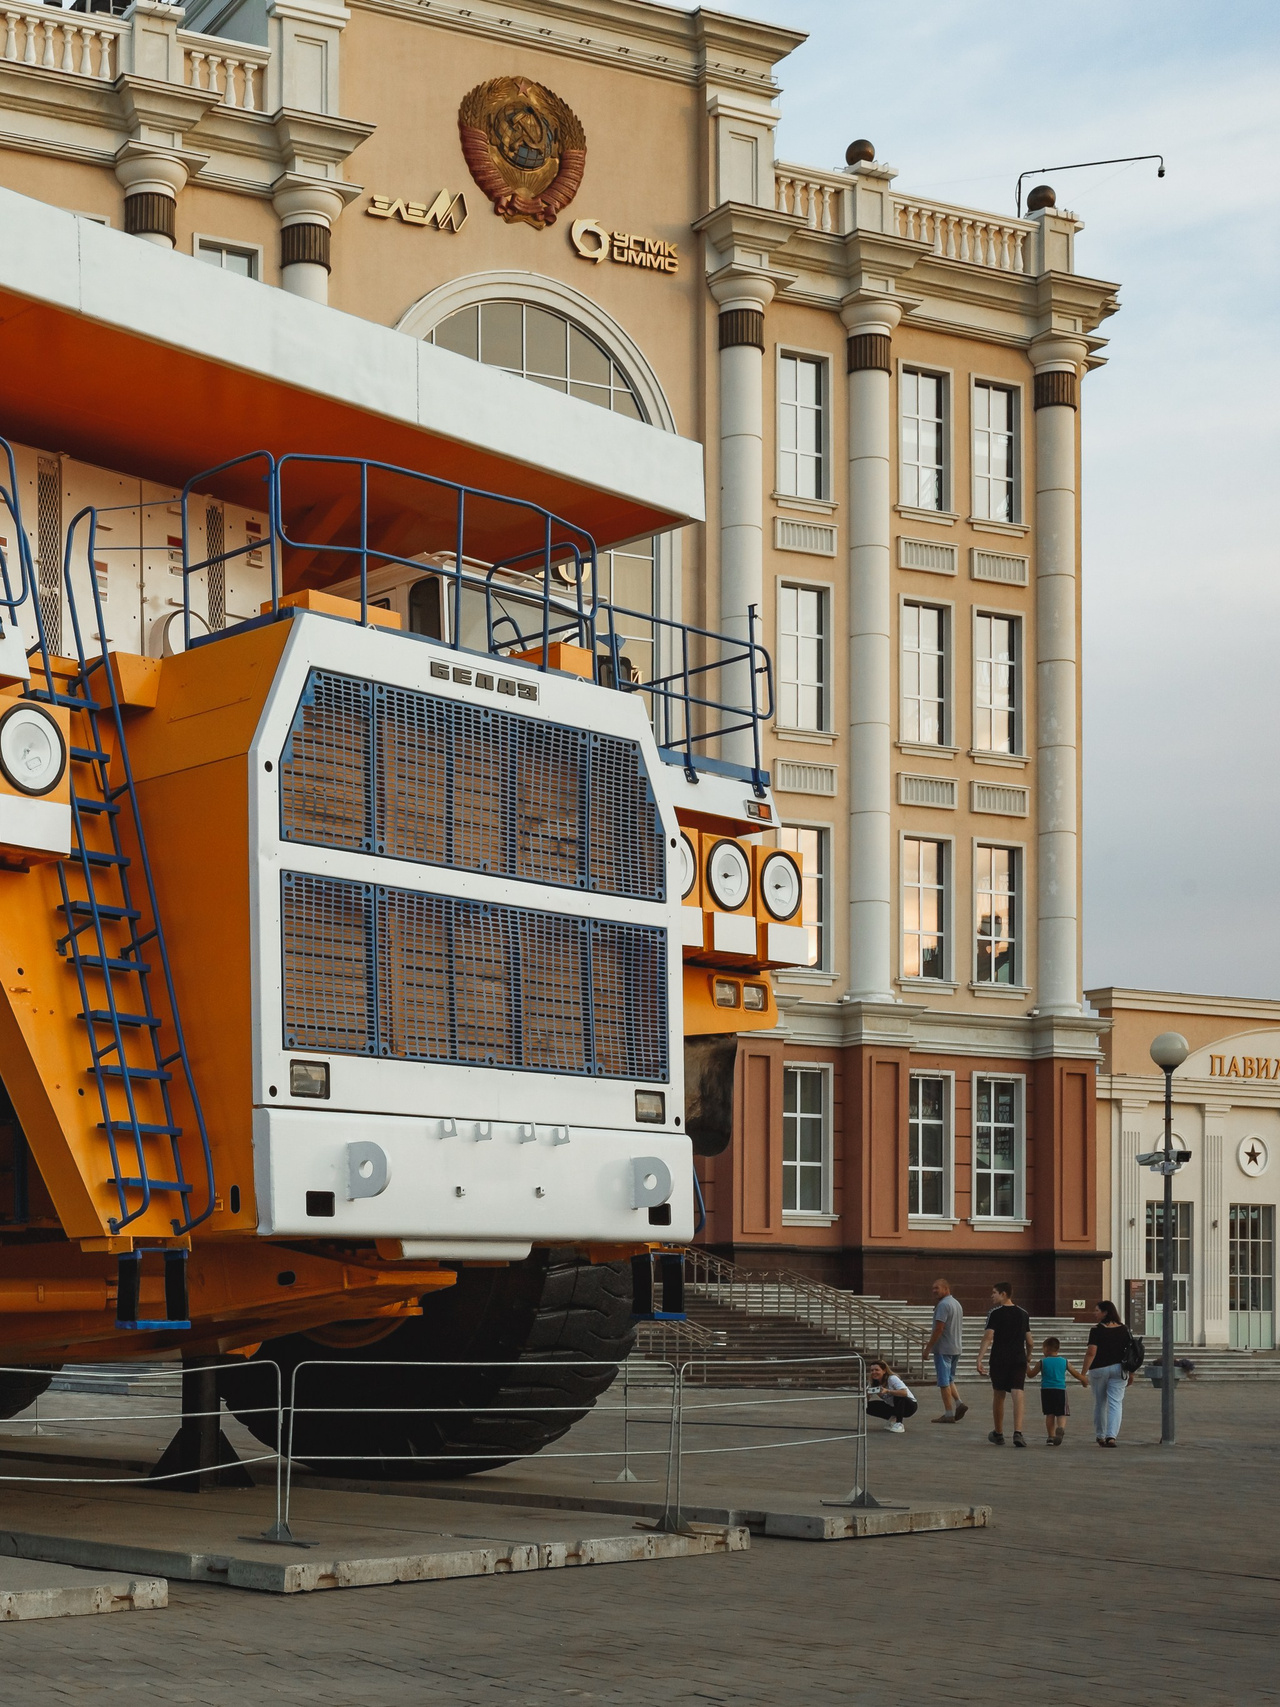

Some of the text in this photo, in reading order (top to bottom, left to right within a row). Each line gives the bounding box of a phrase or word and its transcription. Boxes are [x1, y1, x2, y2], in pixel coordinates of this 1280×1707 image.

[613, 231, 678, 259] УГМК
[613, 246, 679, 273] UMMC
[430, 661, 538, 702] БЕЛАЗ
